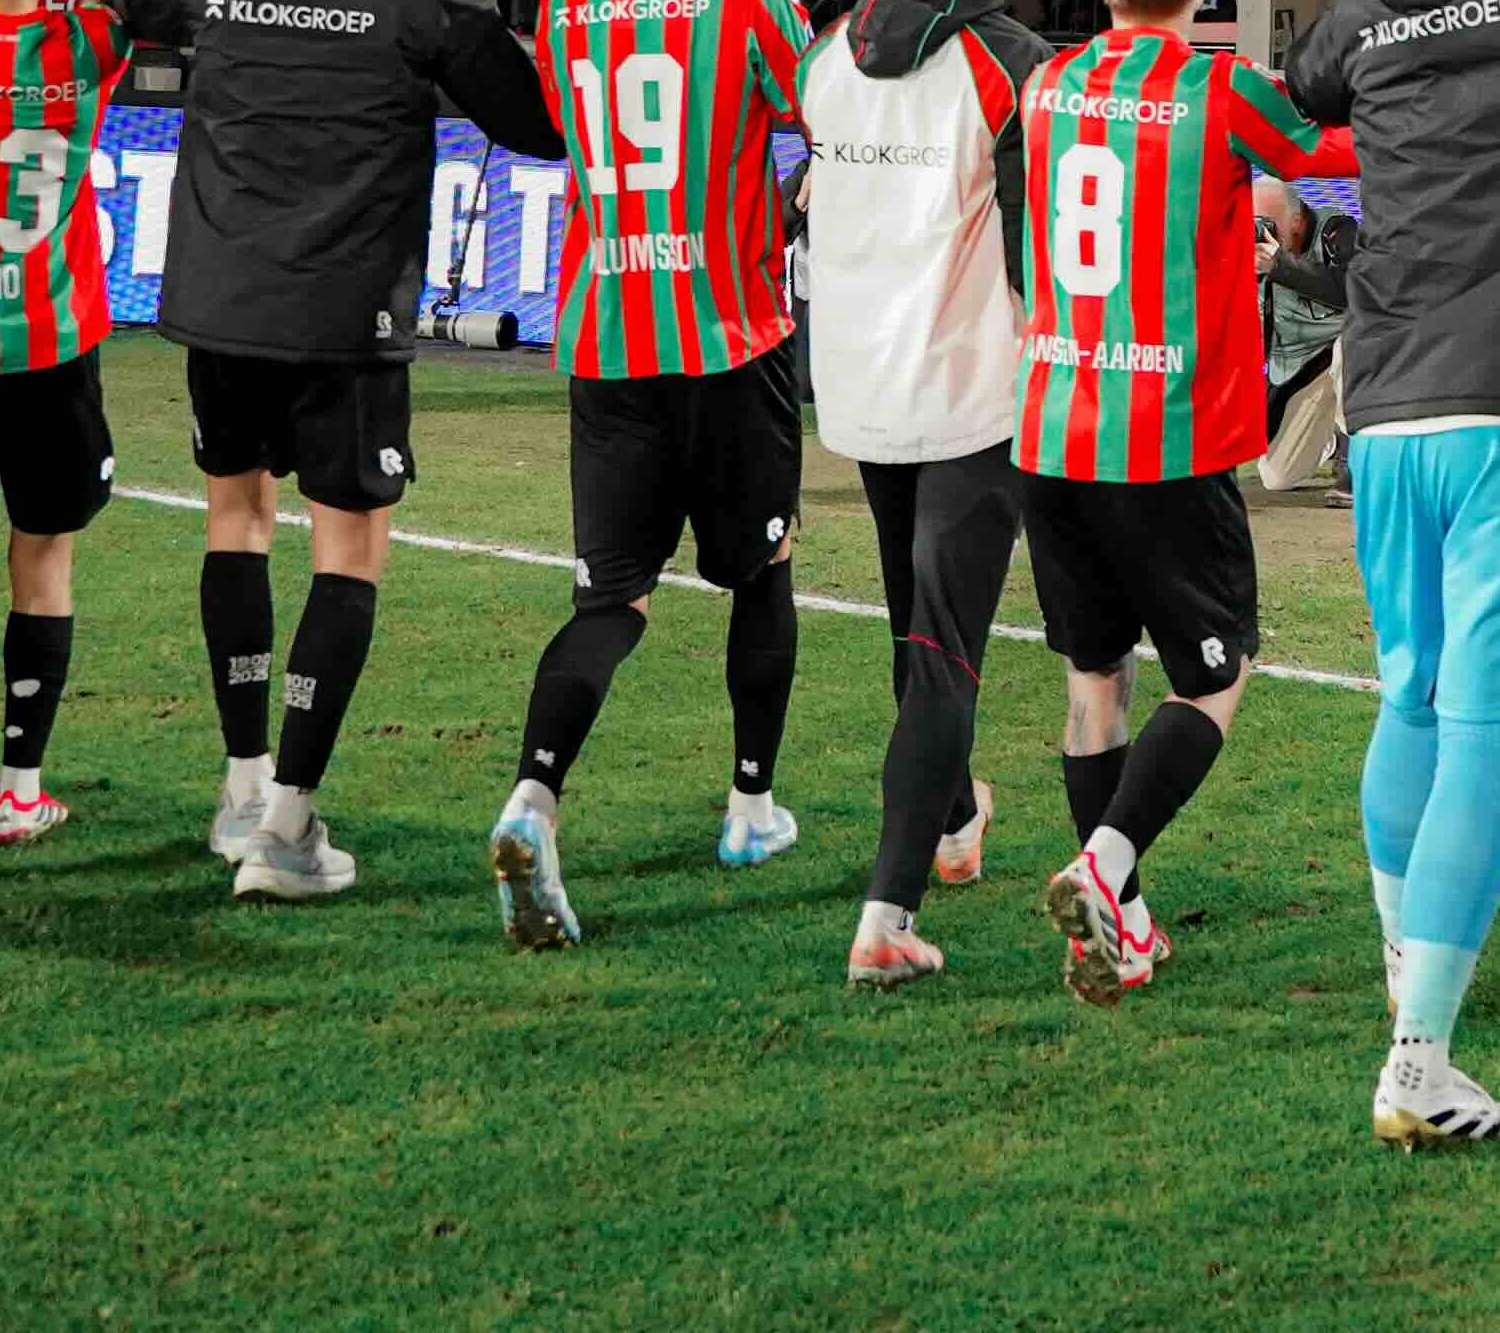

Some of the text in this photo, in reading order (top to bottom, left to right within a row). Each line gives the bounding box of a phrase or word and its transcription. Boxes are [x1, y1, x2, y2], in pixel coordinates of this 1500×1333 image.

[228, 0, 376, 36] KLOKGROEP
[571, 53, 685, 197] 19
[1039, 88, 1189, 127] KLOKGROEP
[1048, 143, 1125, 298] 8
